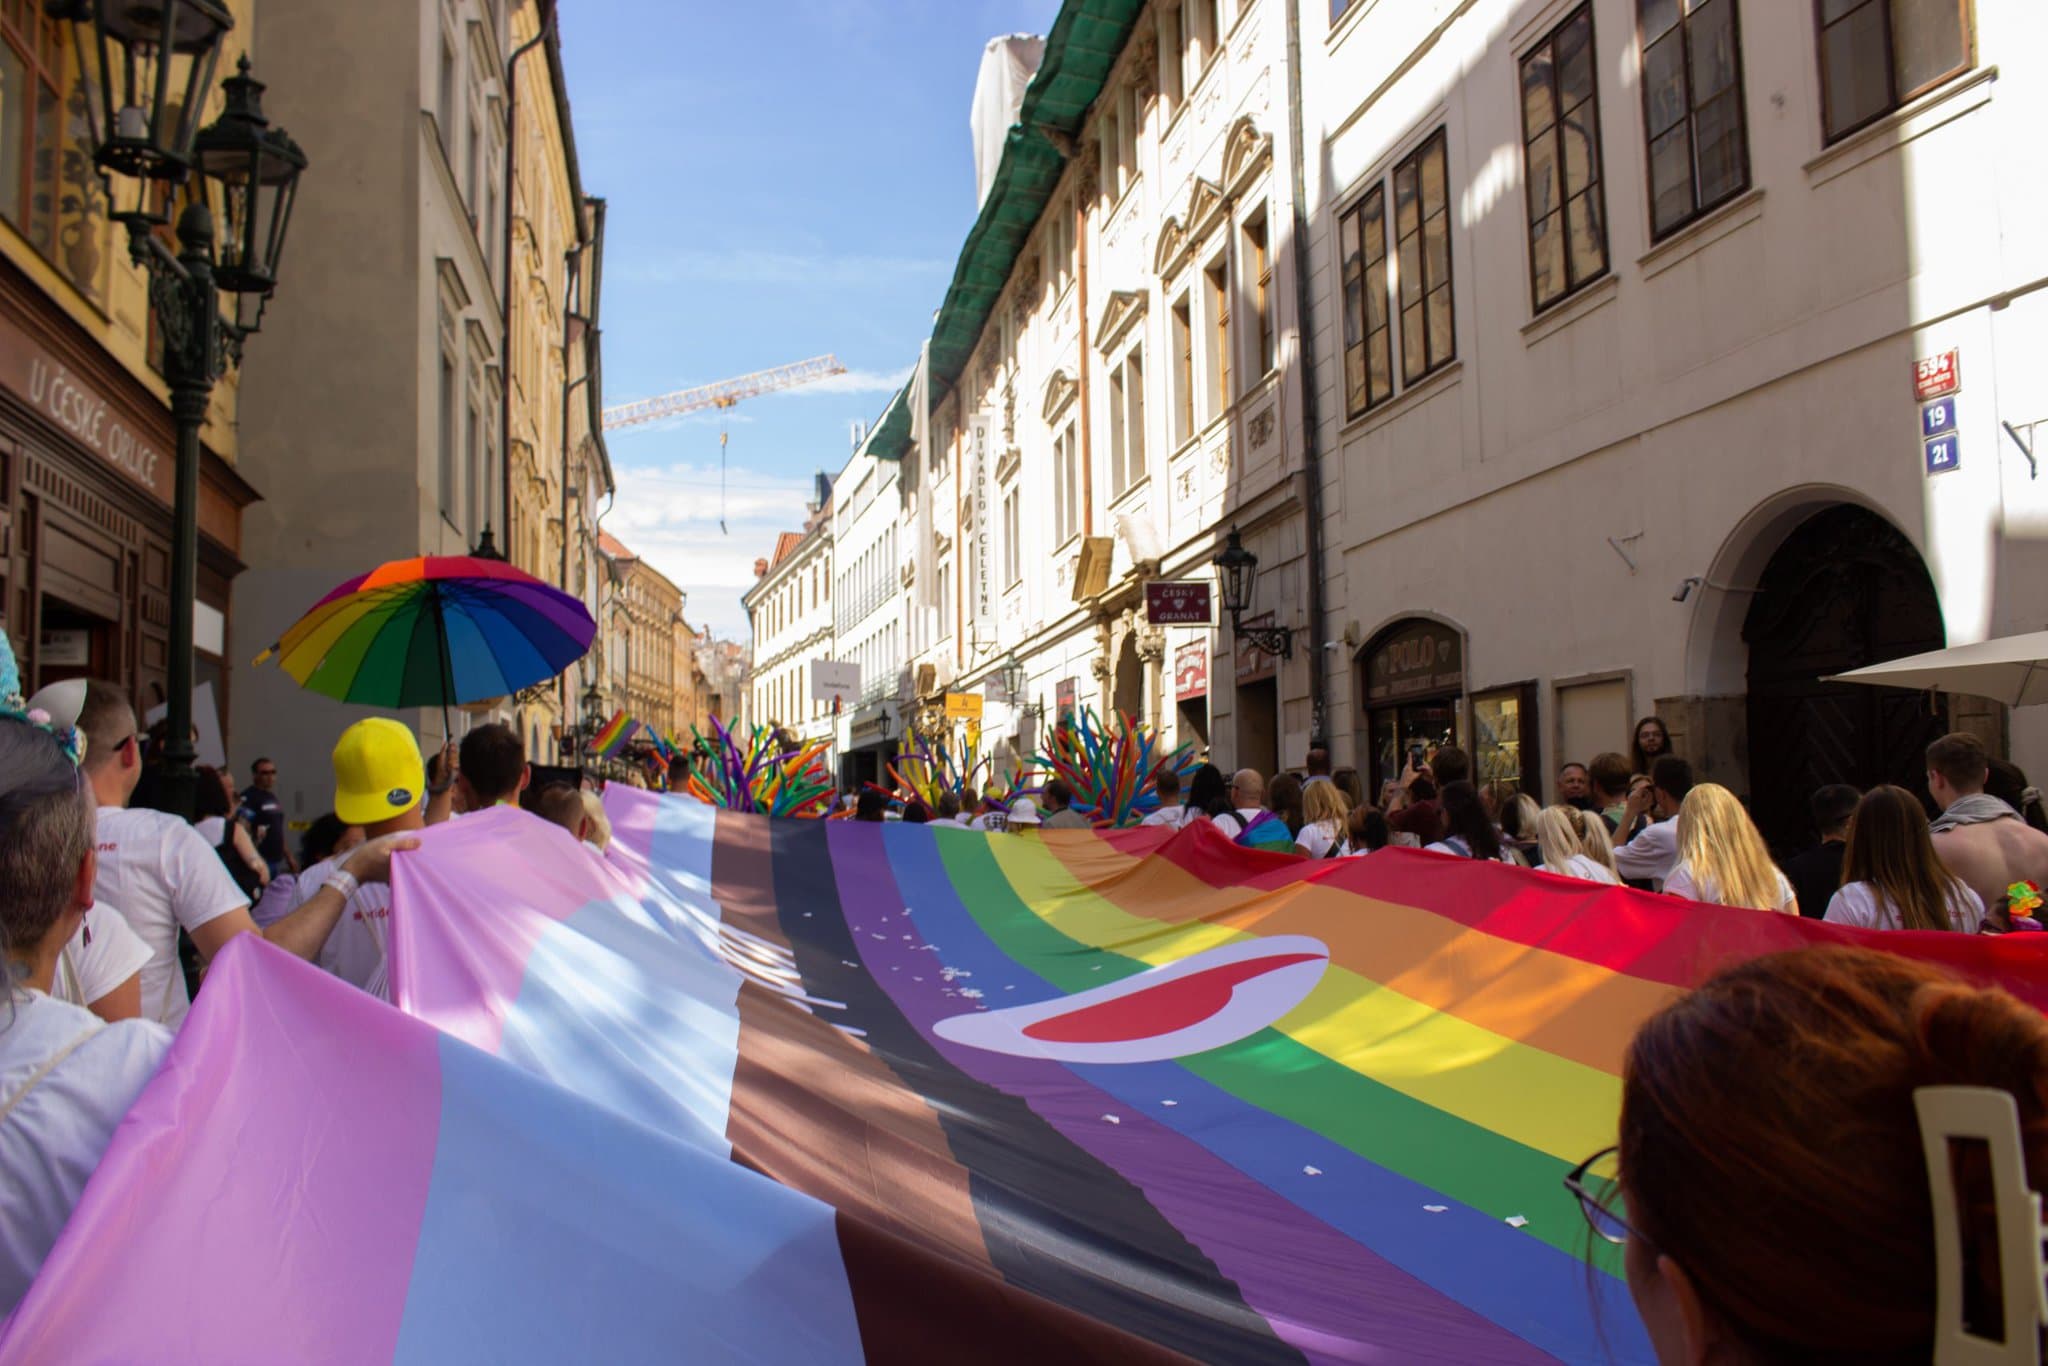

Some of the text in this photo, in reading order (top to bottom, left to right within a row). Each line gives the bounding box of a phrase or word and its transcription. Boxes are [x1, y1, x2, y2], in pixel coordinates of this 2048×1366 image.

[1918, 354, 1949, 379] 594
[31, 359, 158, 488] U ČESKÉ ORLICE
[1928, 405, 1946, 428] 19
[976, 426, 986, 511] DIVADLO
[1932, 443, 1949, 465] 21
[1388, 634, 1435, 674] POLO
